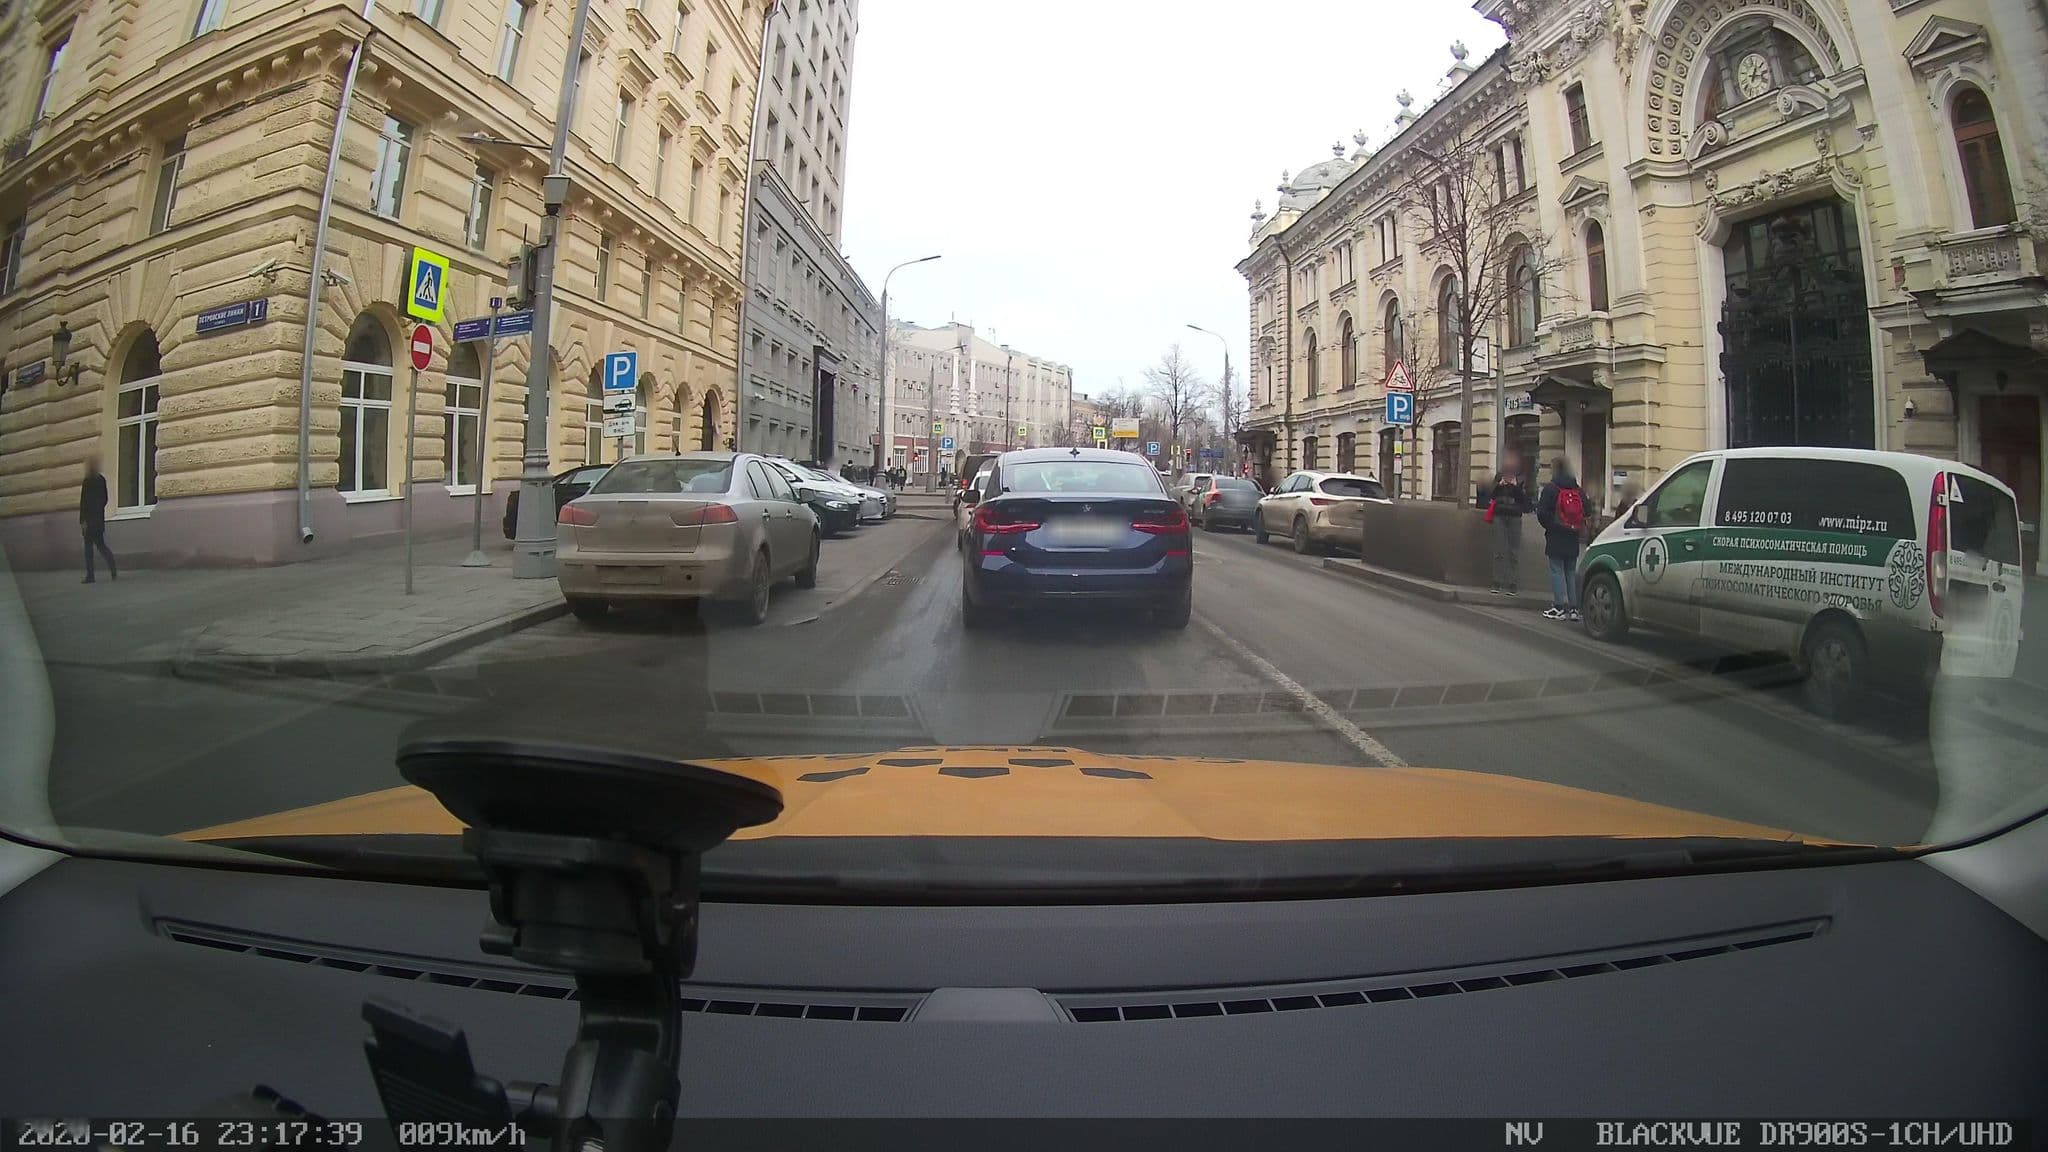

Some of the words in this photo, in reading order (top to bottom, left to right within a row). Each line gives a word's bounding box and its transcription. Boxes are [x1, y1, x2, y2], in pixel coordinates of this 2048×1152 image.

[255, 303, 260, 317] 1
[612, 356, 631, 386] P
[1393, 396, 1408, 420] P
[1725, 510, 1730, 522] 8
[1732, 510, 1748, 522] 495
[1750, 511, 1765, 523] 120
[1768, 511, 1779, 523] 07
[1780, 512, 1792, 524] 03
[1818, 515, 1887, 533] www.mipz.ru
[1713, 536, 1739, 548] СКОРАЯ
[1740, 538, 1827, 554] ПСИХОСОМАТИЧЕСКАЯ
[1828, 543, 1868, 558] ПОМОЩЬ
[1719, 562, 1817, 584] МЕЖДУНАРОДНЫЙ
[1820, 571, 1884, 592] ИНСТИТУТ
[1702, 578, 1820, 602] ПСИХОСОМАТИЧЕСКОГО
[1823, 592, 1882, 612] ЗДОРОВЬЯ
